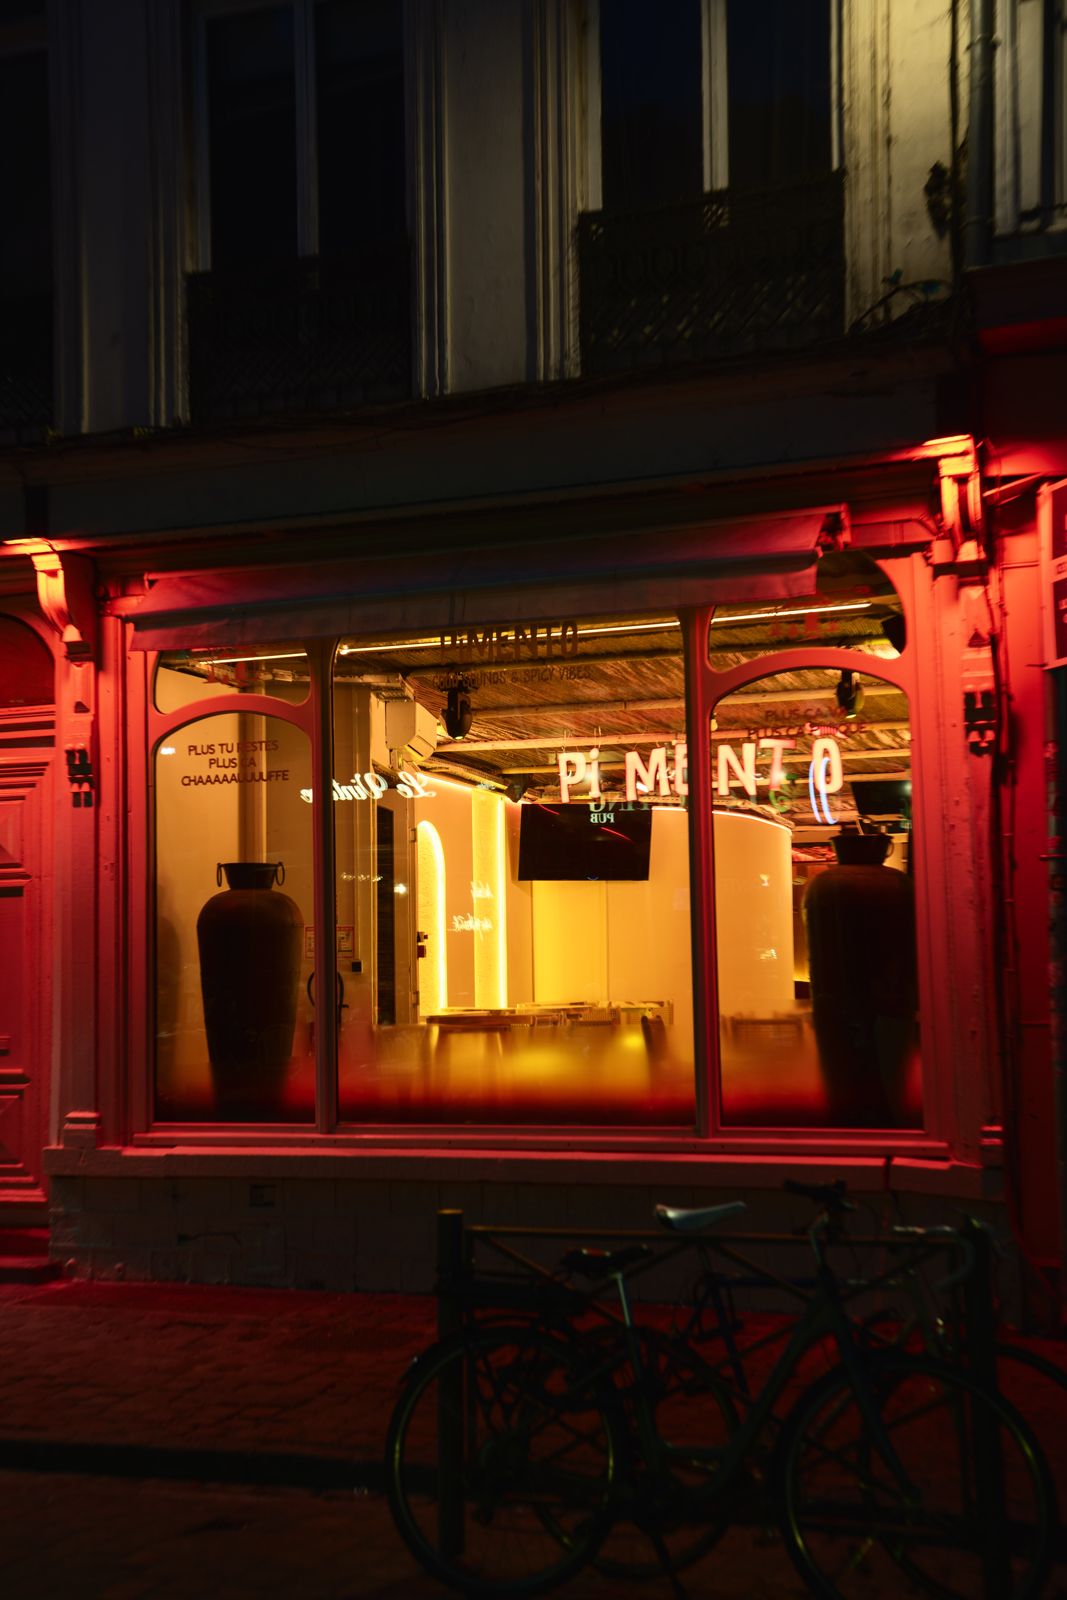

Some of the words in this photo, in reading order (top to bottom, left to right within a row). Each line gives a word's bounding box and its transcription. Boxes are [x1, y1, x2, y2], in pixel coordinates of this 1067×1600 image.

[523, 666, 553, 682] SPICY
[558, 664, 593, 681] VIBES
[187, 743, 216, 756] PLUS
[218, 741, 235, 754] TU
[236, 739, 280, 754] RESTES
[208, 757, 238, 769] PLUS
